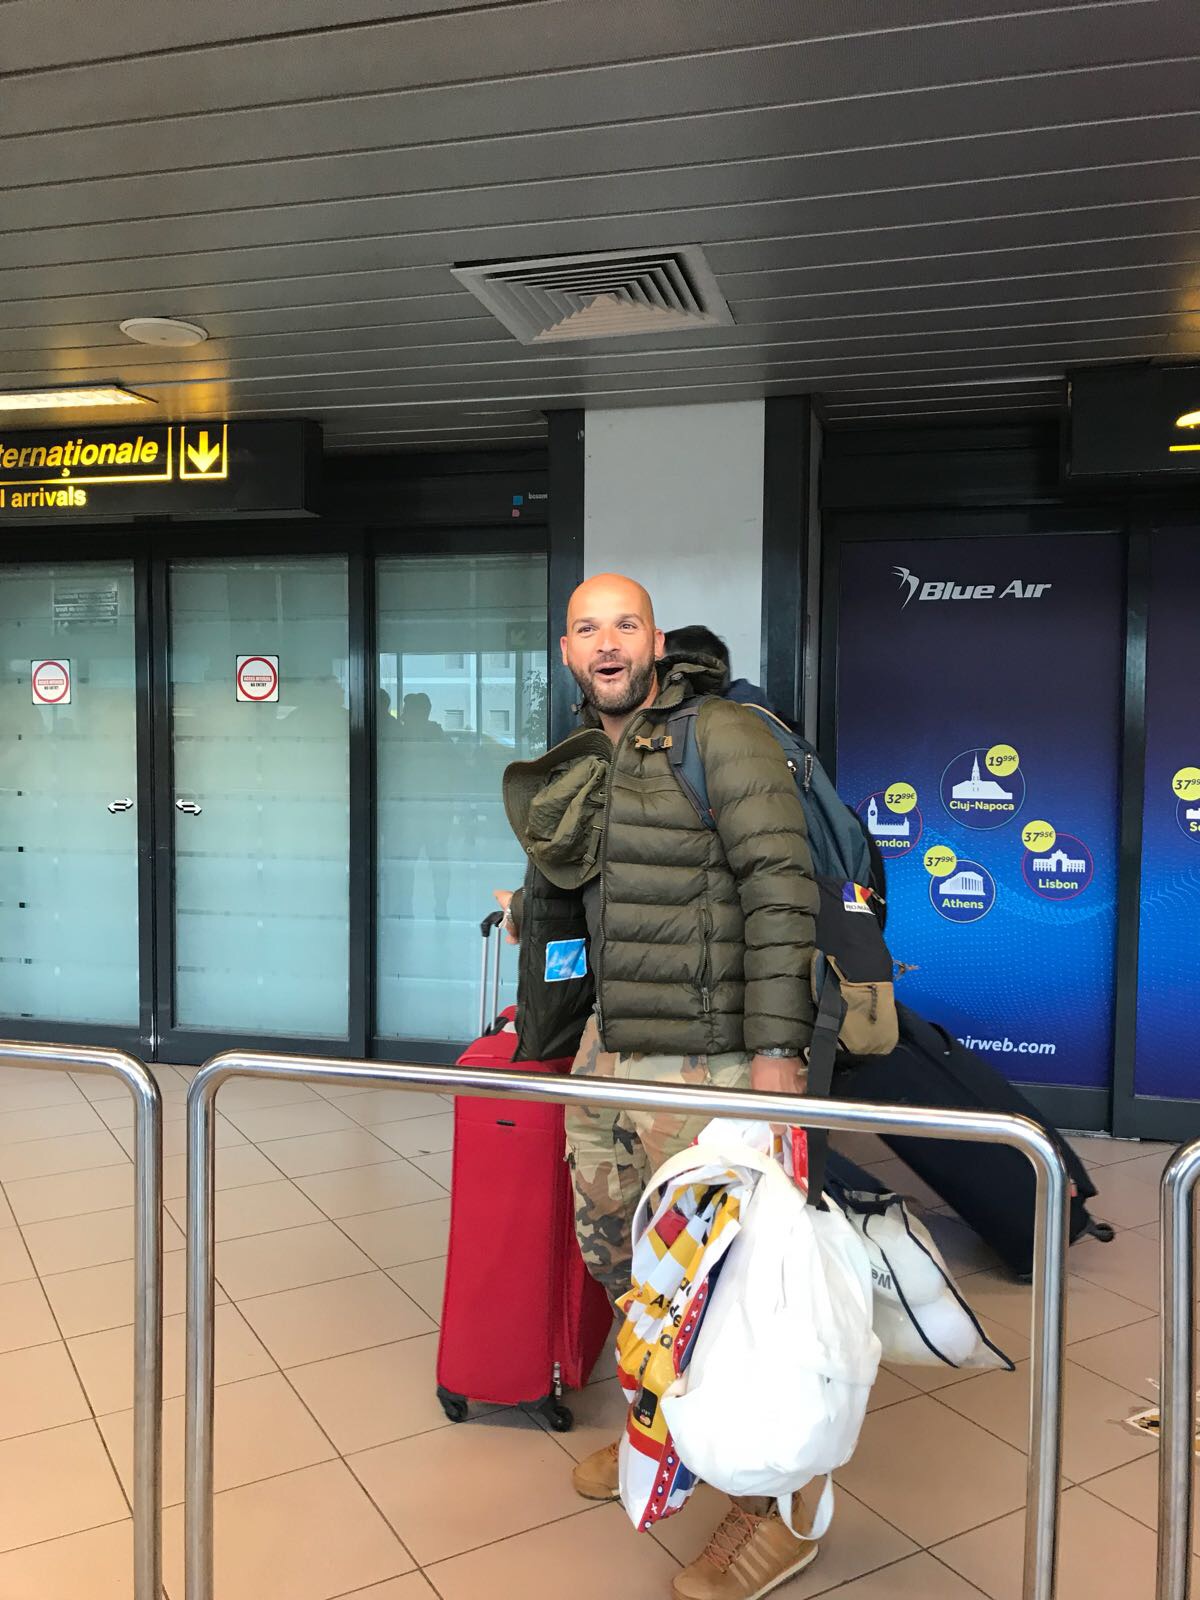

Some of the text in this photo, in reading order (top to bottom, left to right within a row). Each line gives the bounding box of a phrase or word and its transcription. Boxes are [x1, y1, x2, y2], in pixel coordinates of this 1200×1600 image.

[11, 486, 87, 508] arrivals
[919, 579, 1052, 601] Blue Air
[949, 800, 1015, 812] Cluj-Napoca
[875, 838, 911, 848] ondon
[1038, 878, 1079, 890] Lisbon
[942, 898, 984, 909] Athens
